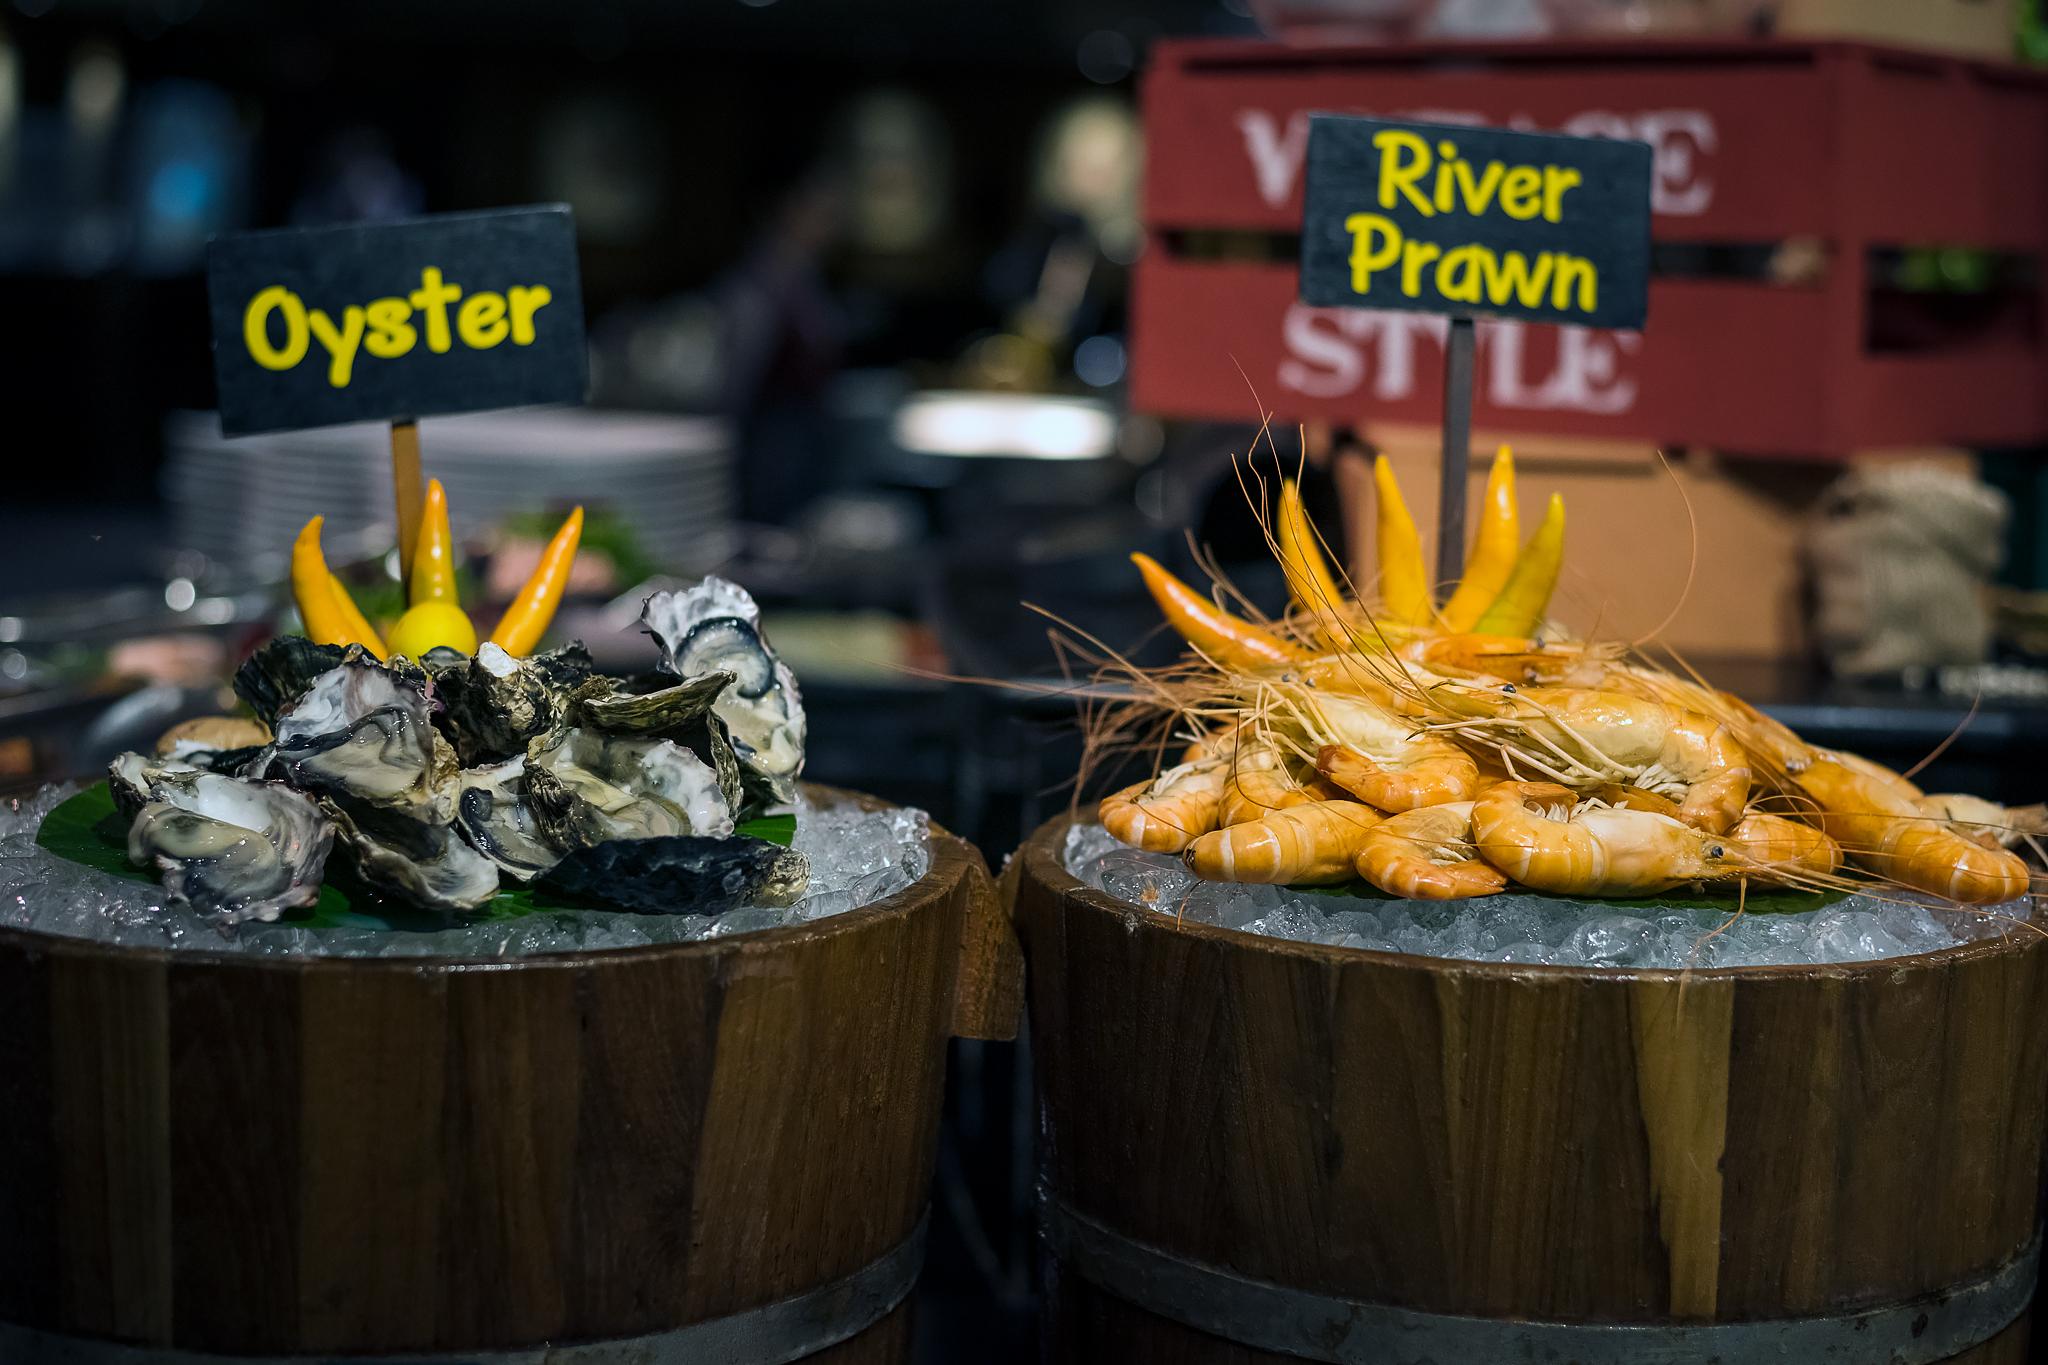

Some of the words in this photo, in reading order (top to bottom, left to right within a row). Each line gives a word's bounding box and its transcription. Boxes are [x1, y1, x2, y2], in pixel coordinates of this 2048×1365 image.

[1372, 129, 1582, 224] River
[1344, 211, 1598, 313] Prawn
[243, 266, 552, 389] Oyster
[1278, 303, 1640, 414] STLE
